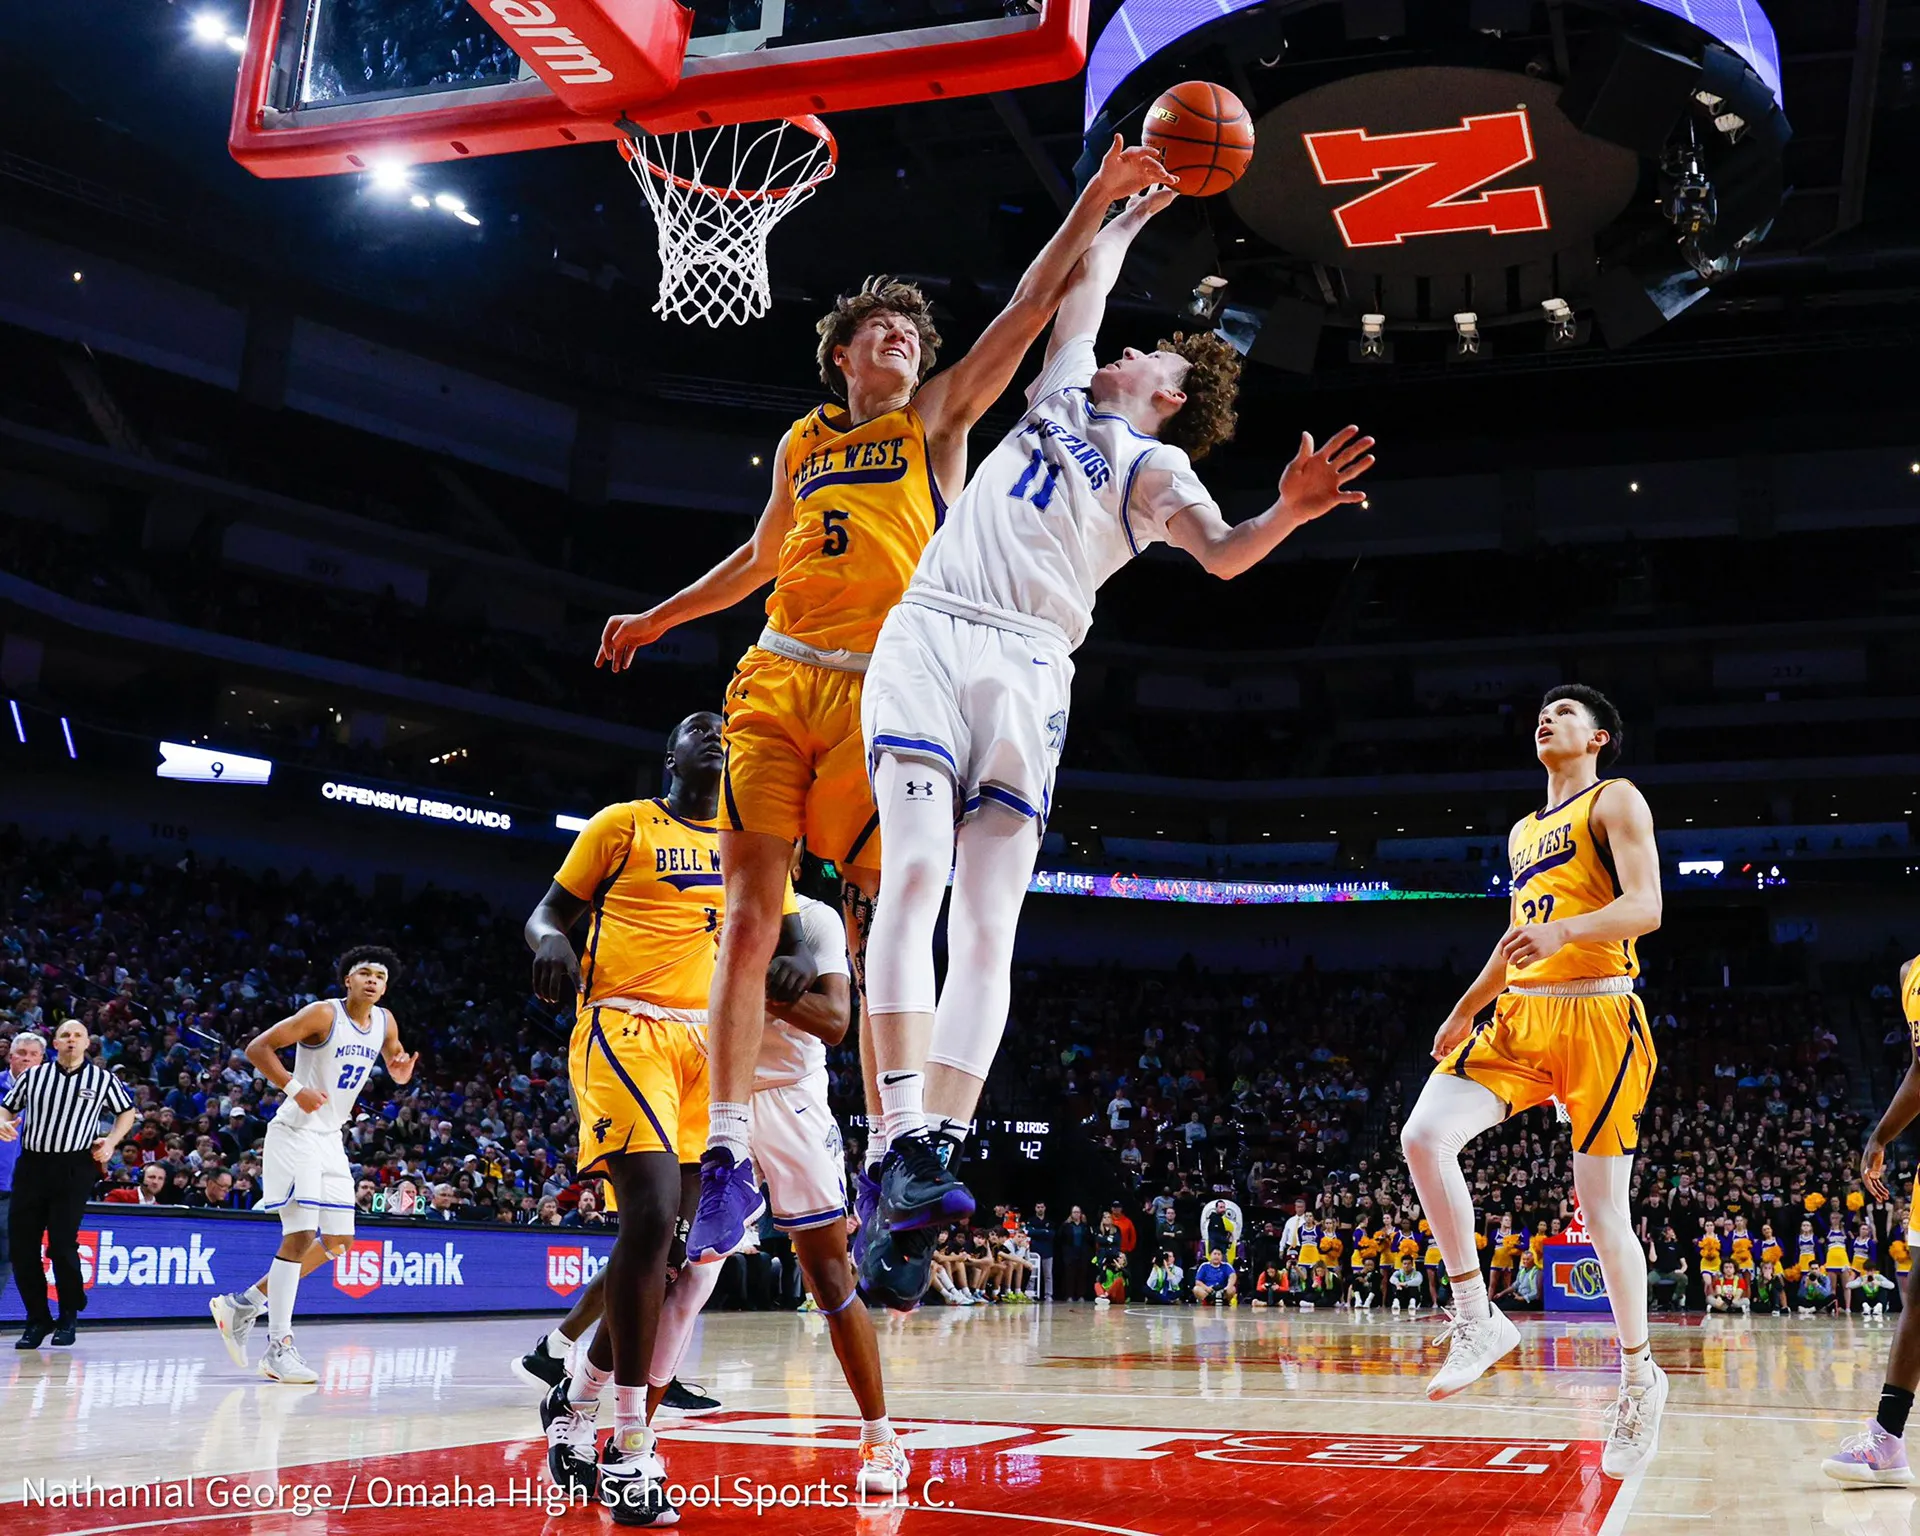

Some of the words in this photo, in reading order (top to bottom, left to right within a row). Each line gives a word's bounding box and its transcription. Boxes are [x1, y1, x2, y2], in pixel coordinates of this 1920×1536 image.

[1302, 108, 1551, 248] N
[844, 436, 904, 468] WEST
[822, 509, 849, 557] 5
[211, 761, 224, 779] 9
[321, 781, 419, 815] OFFENSIVE
[419, 799, 511, 830] REBOUNDS
[1537, 822, 1572, 859] WEST
[655, 848, 703, 872] BELL
[337, 1063, 367, 1090] 23
[1003, 1120, 1012, 1133] T
[1015, 1120, 1050, 1134] BIRDS
[1019, 1140, 1042, 1160] 42
[336, 1240, 464, 1287] usbank
